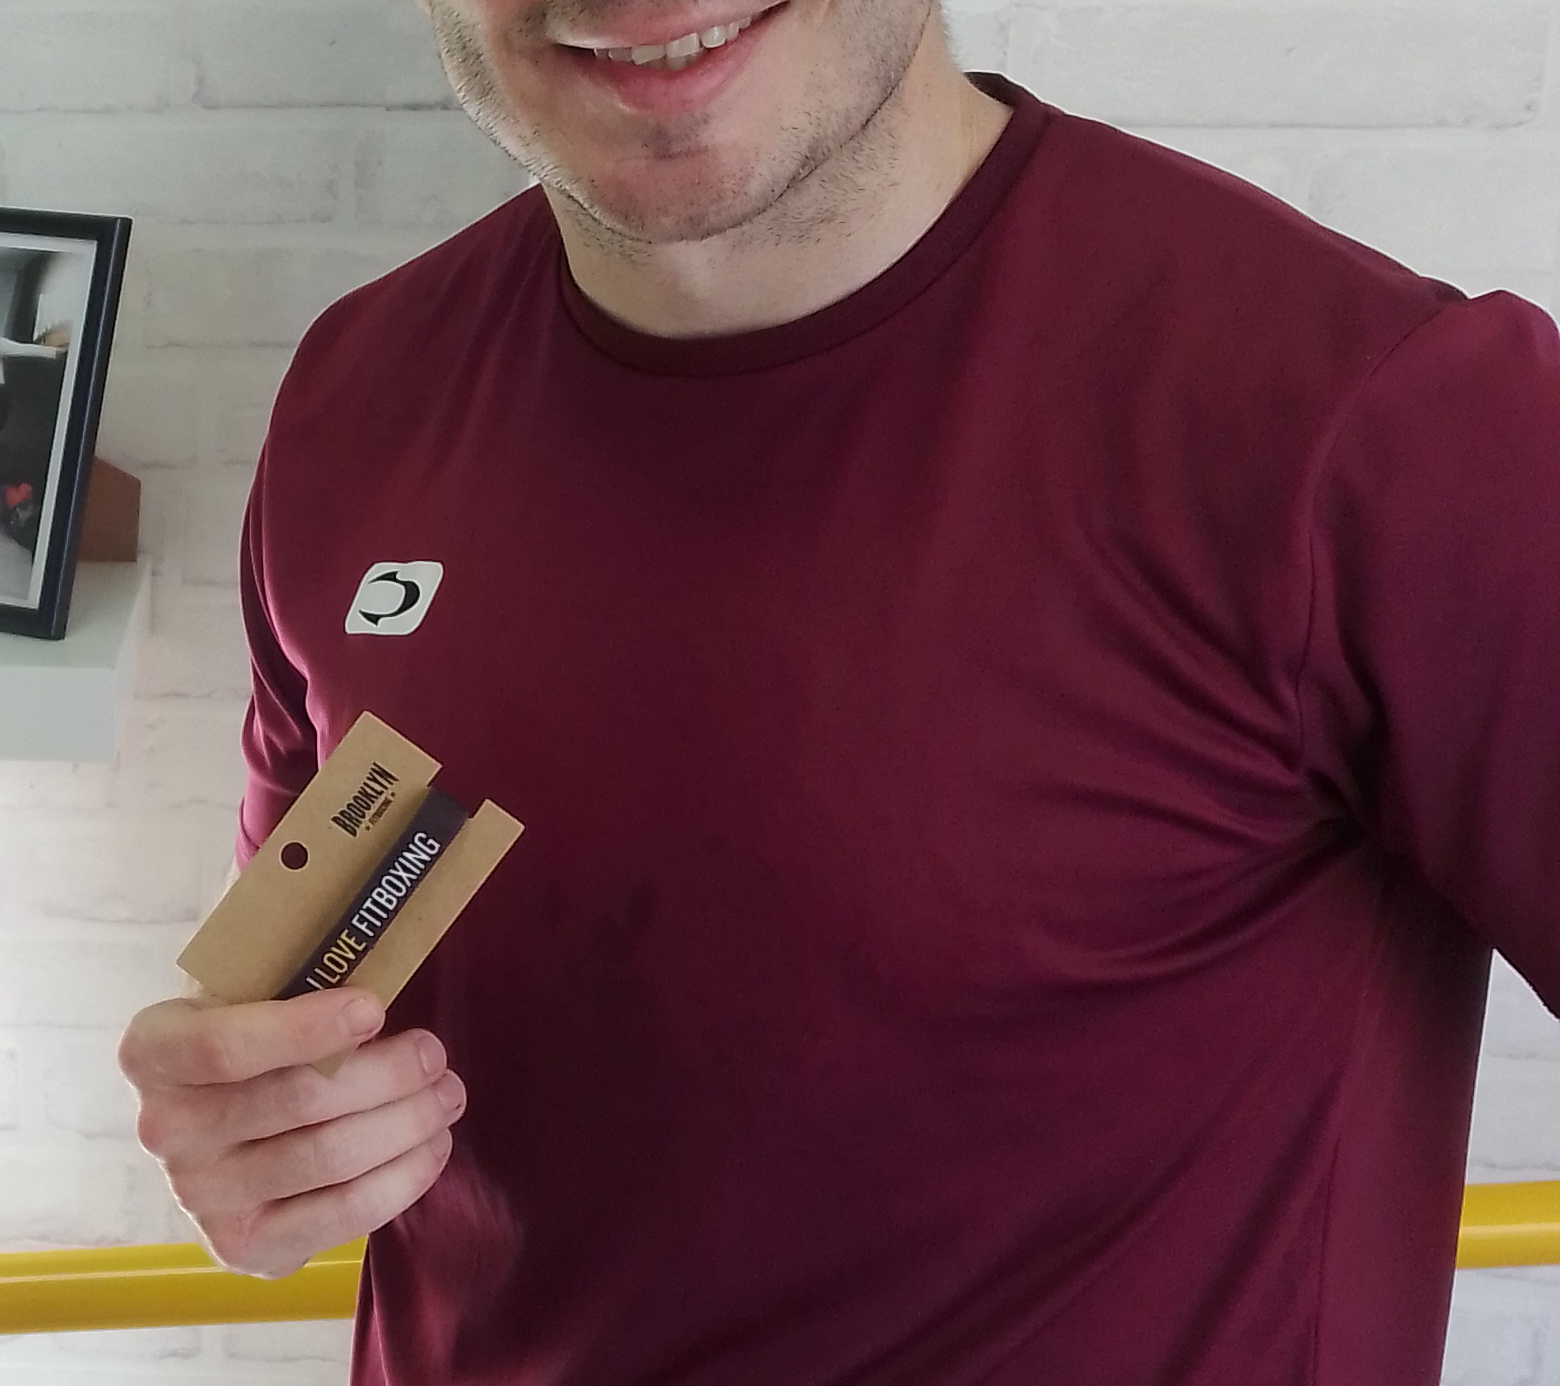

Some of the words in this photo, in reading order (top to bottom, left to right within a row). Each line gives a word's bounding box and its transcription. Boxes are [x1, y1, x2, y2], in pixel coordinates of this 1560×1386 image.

[329, 760, 400, 838] BROOKLYN
[313, 927, 368, 985] LOVE
[350, 830, 442, 938] FITBOXING
